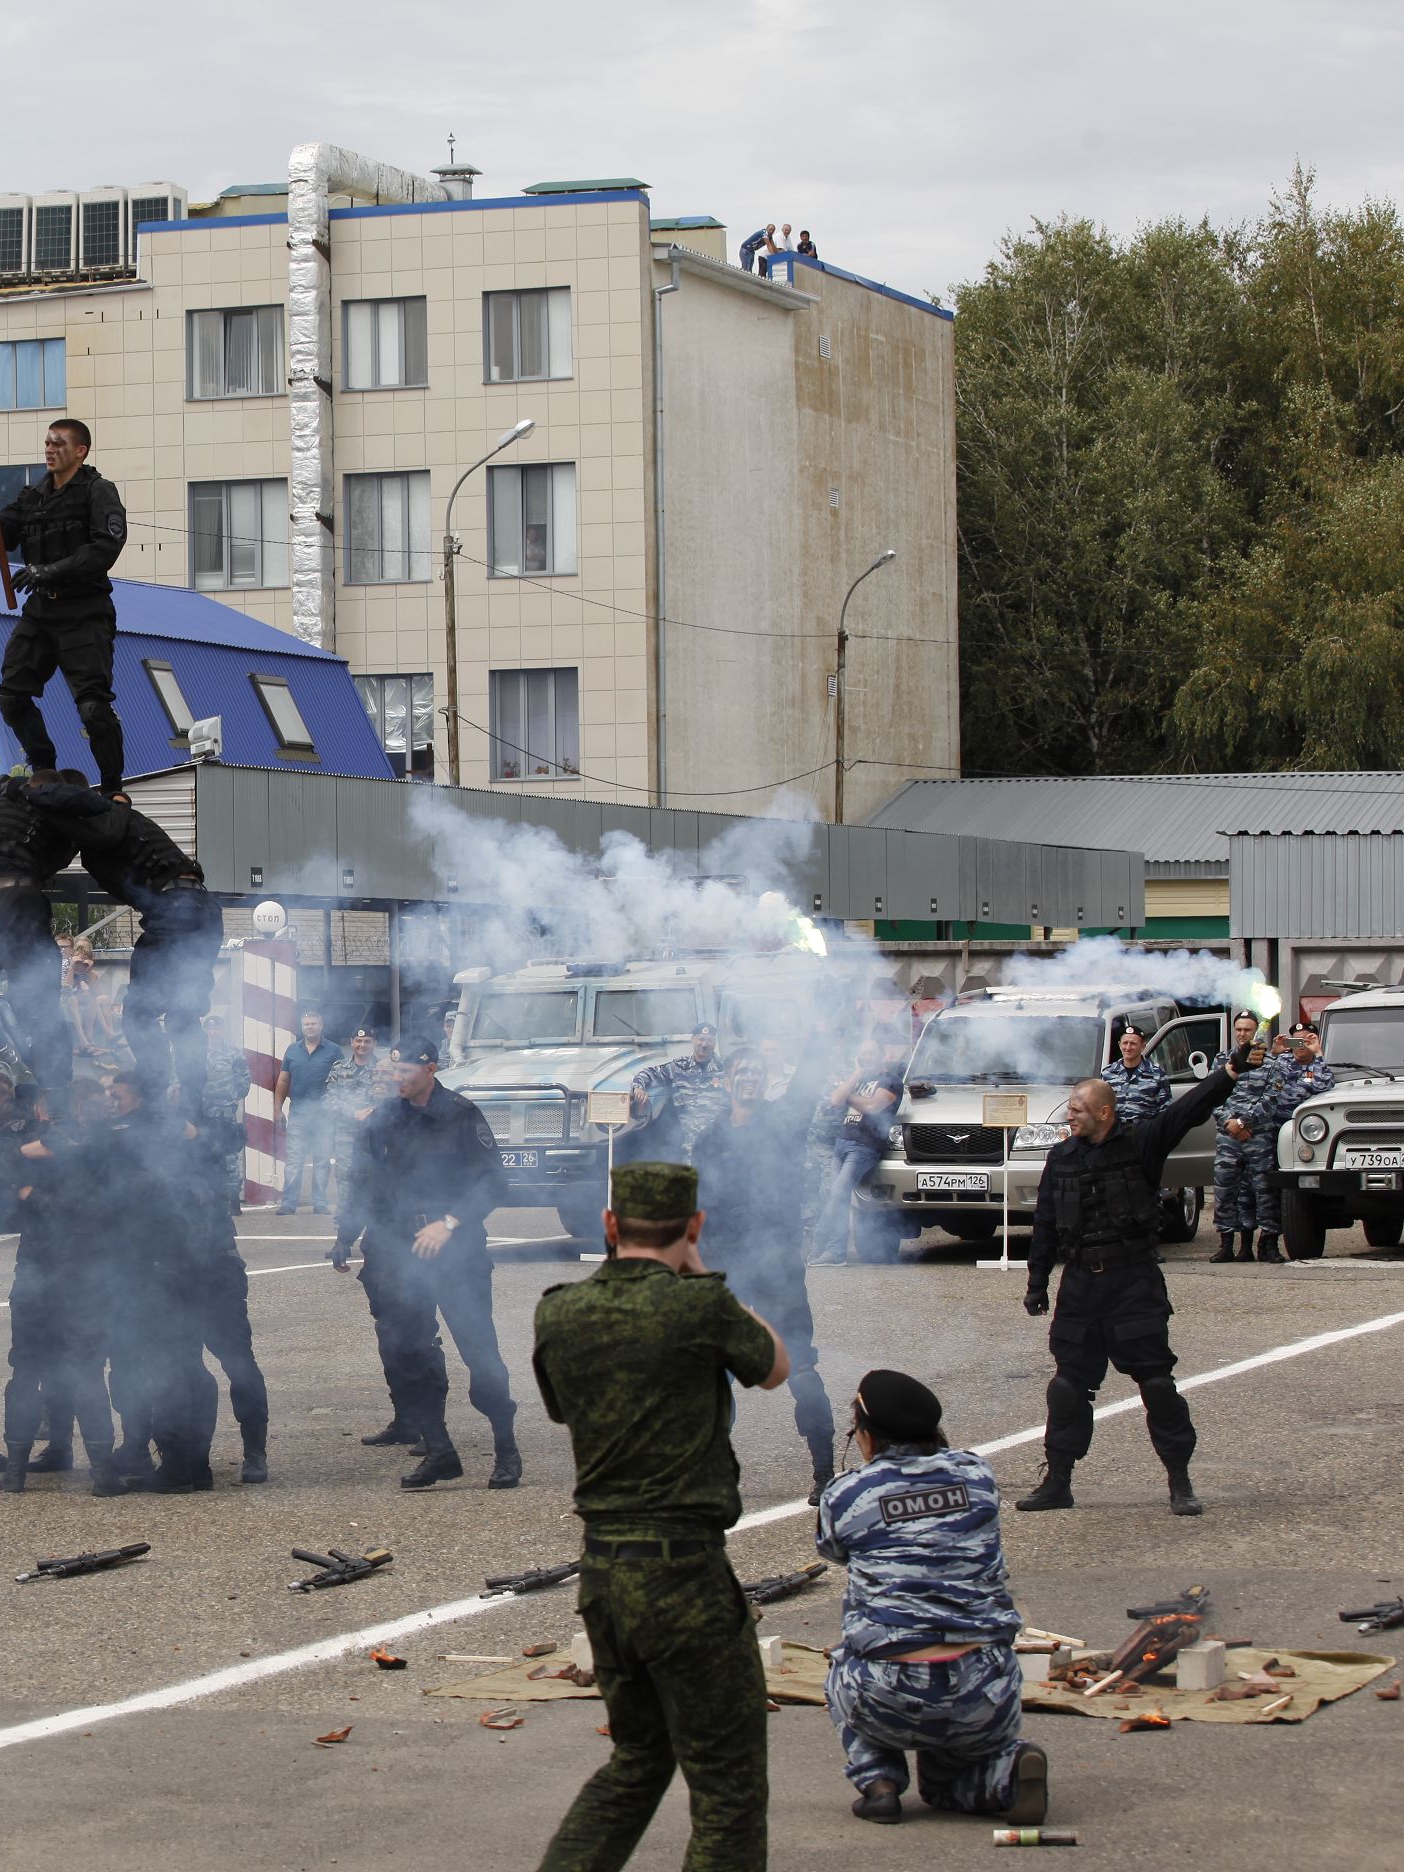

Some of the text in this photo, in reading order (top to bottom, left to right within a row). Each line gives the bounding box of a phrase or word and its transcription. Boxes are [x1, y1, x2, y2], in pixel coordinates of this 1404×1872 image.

[501, 1153, 534, 1166] 22 26
[967, 1175, 984, 1185] 126
[887, 1489, 964, 1515] ОМОН
